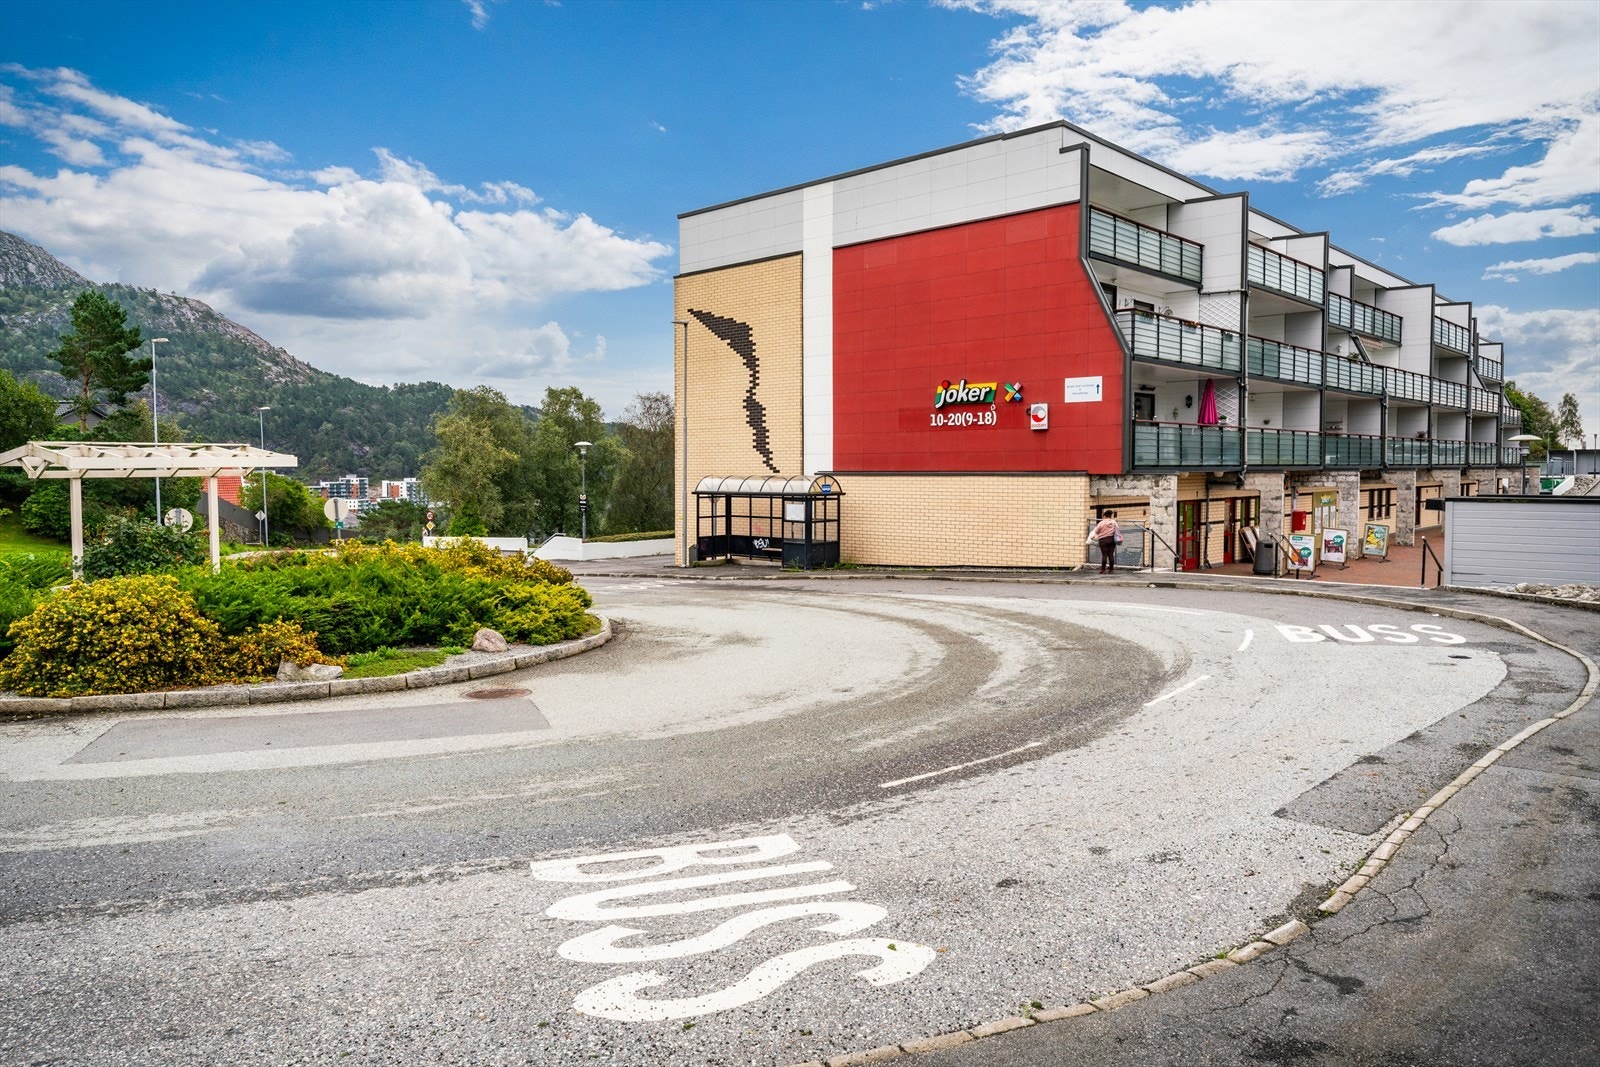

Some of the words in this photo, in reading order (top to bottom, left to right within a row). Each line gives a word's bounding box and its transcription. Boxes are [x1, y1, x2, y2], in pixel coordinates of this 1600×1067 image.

[935, 379, 990, 409] joker
[930, 411, 997, 427] 10-20(9-18)
[1274, 624, 1466, 644] BUSS
[529, 833, 937, 1022] BUSS
